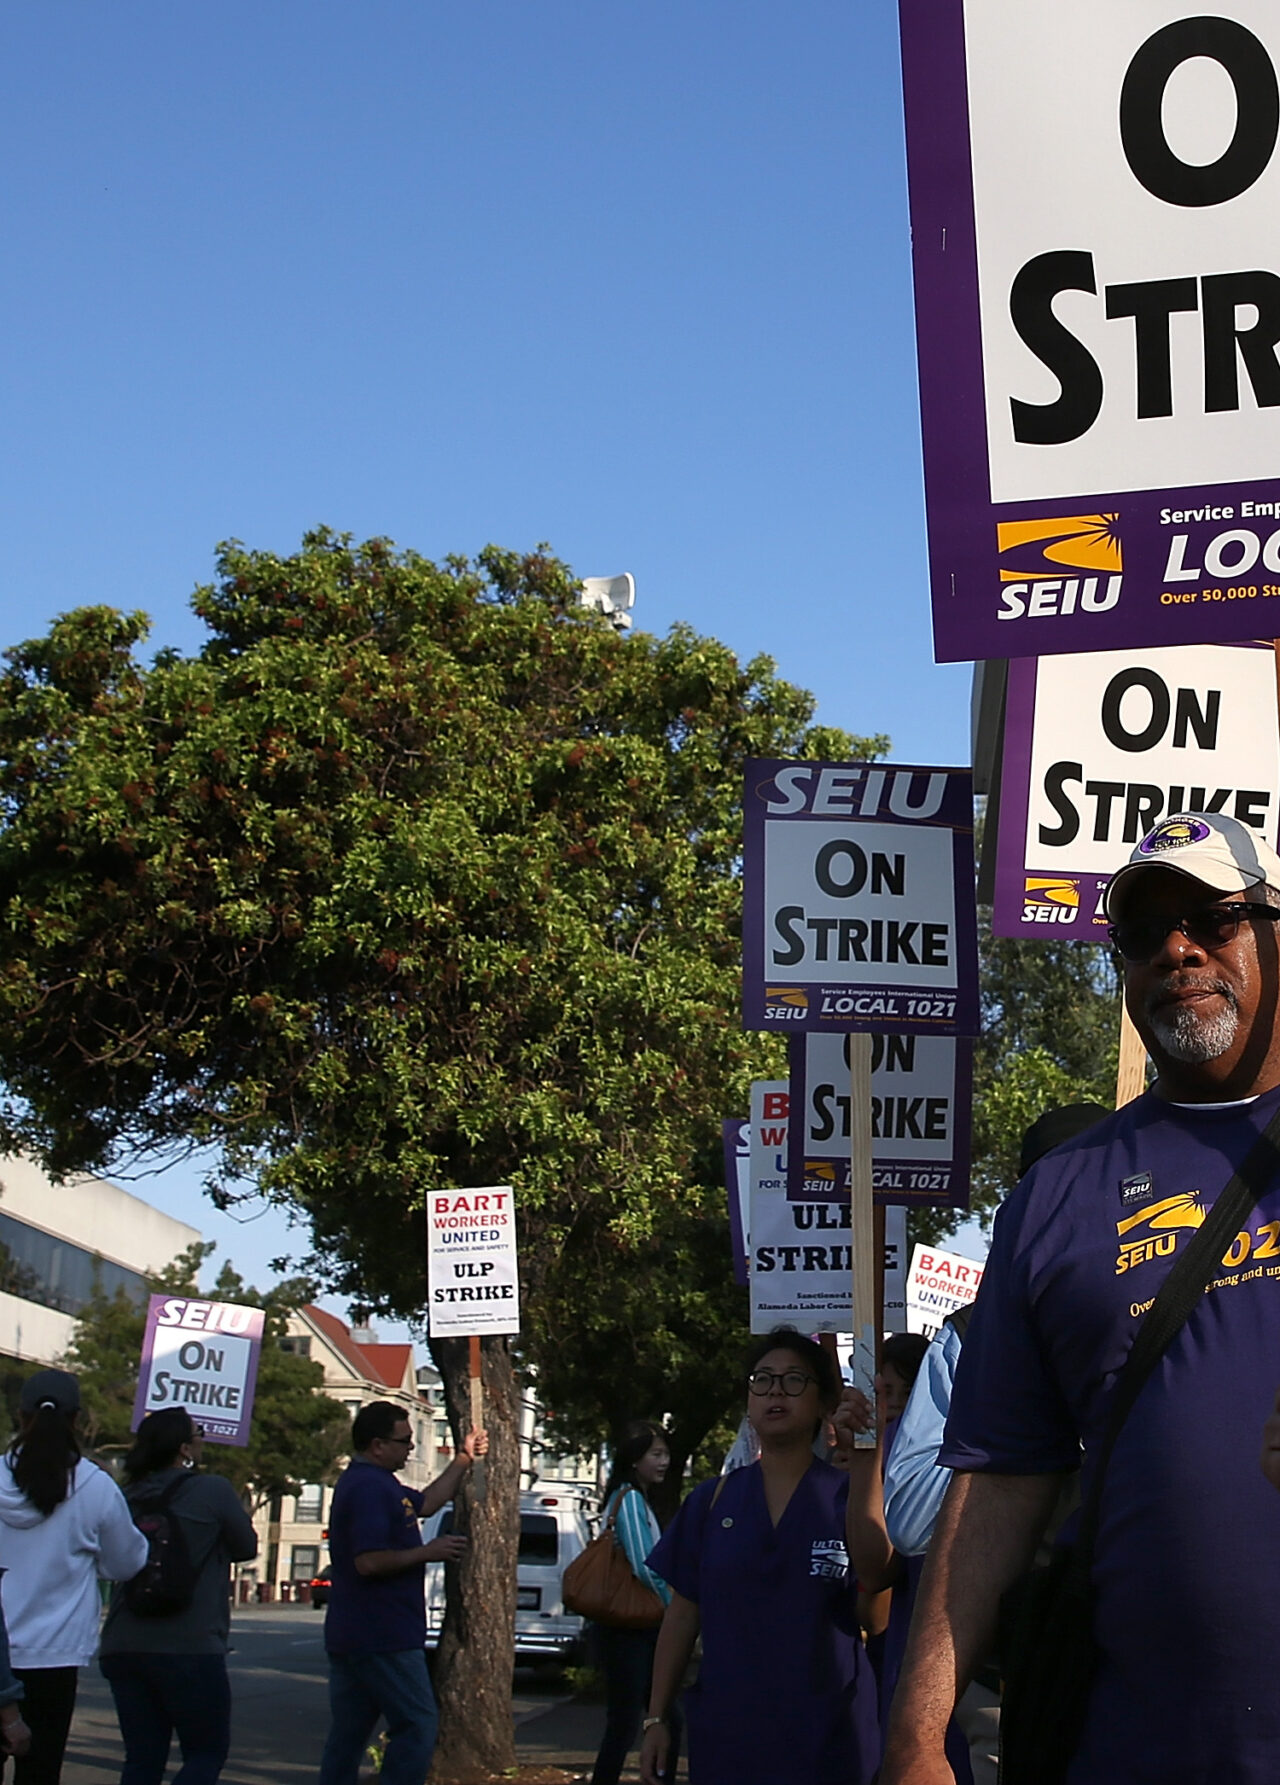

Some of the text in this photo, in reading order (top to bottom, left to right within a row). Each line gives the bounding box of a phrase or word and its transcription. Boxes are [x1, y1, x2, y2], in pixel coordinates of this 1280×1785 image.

[1160, 503, 1234, 525] Service
[997, 575, 1123, 620] SEIU
[1160, 592, 1197, 605] Over
[1202, 586, 1257, 603] 50,000
[1101, 667, 1221, 753] ON
[767, 767, 948, 819] SEIU
[815, 839, 905, 898] ON
[1021, 905, 1080, 924] SEIU
[772, 905, 949, 967] STRIKE
[764, 1007, 808, 1020] SEIU
[821, 997, 956, 1017] LOCAL 1021
[803, 1181, 835, 1192] SEIU
[844, 1172, 950, 1189] LCAL 1021
[1123, 1183, 1150, 1197] SEIU
[434, 1194, 508, 1213] BART
[433, 1214, 508, 1229] WORKERS
[442, 1230, 500, 1244] UNITED
[756, 1245, 898, 1271] STRIE
[1115, 1234, 1176, 1275] SEIU
[454, 1262, 494, 1278] ULP
[919, 1254, 983, 1286] BART
[1204, 1274, 1240, 1293] srong
[1241, 1266, 1263, 1282] and
[434, 1285, 514, 1303] STRIKE
[158, 1299, 250, 1334] SEIU
[179, 1341, 224, 1372] ON
[151, 1371, 240, 1409] STRIKE
[809, 1563, 848, 1578] SEIU
